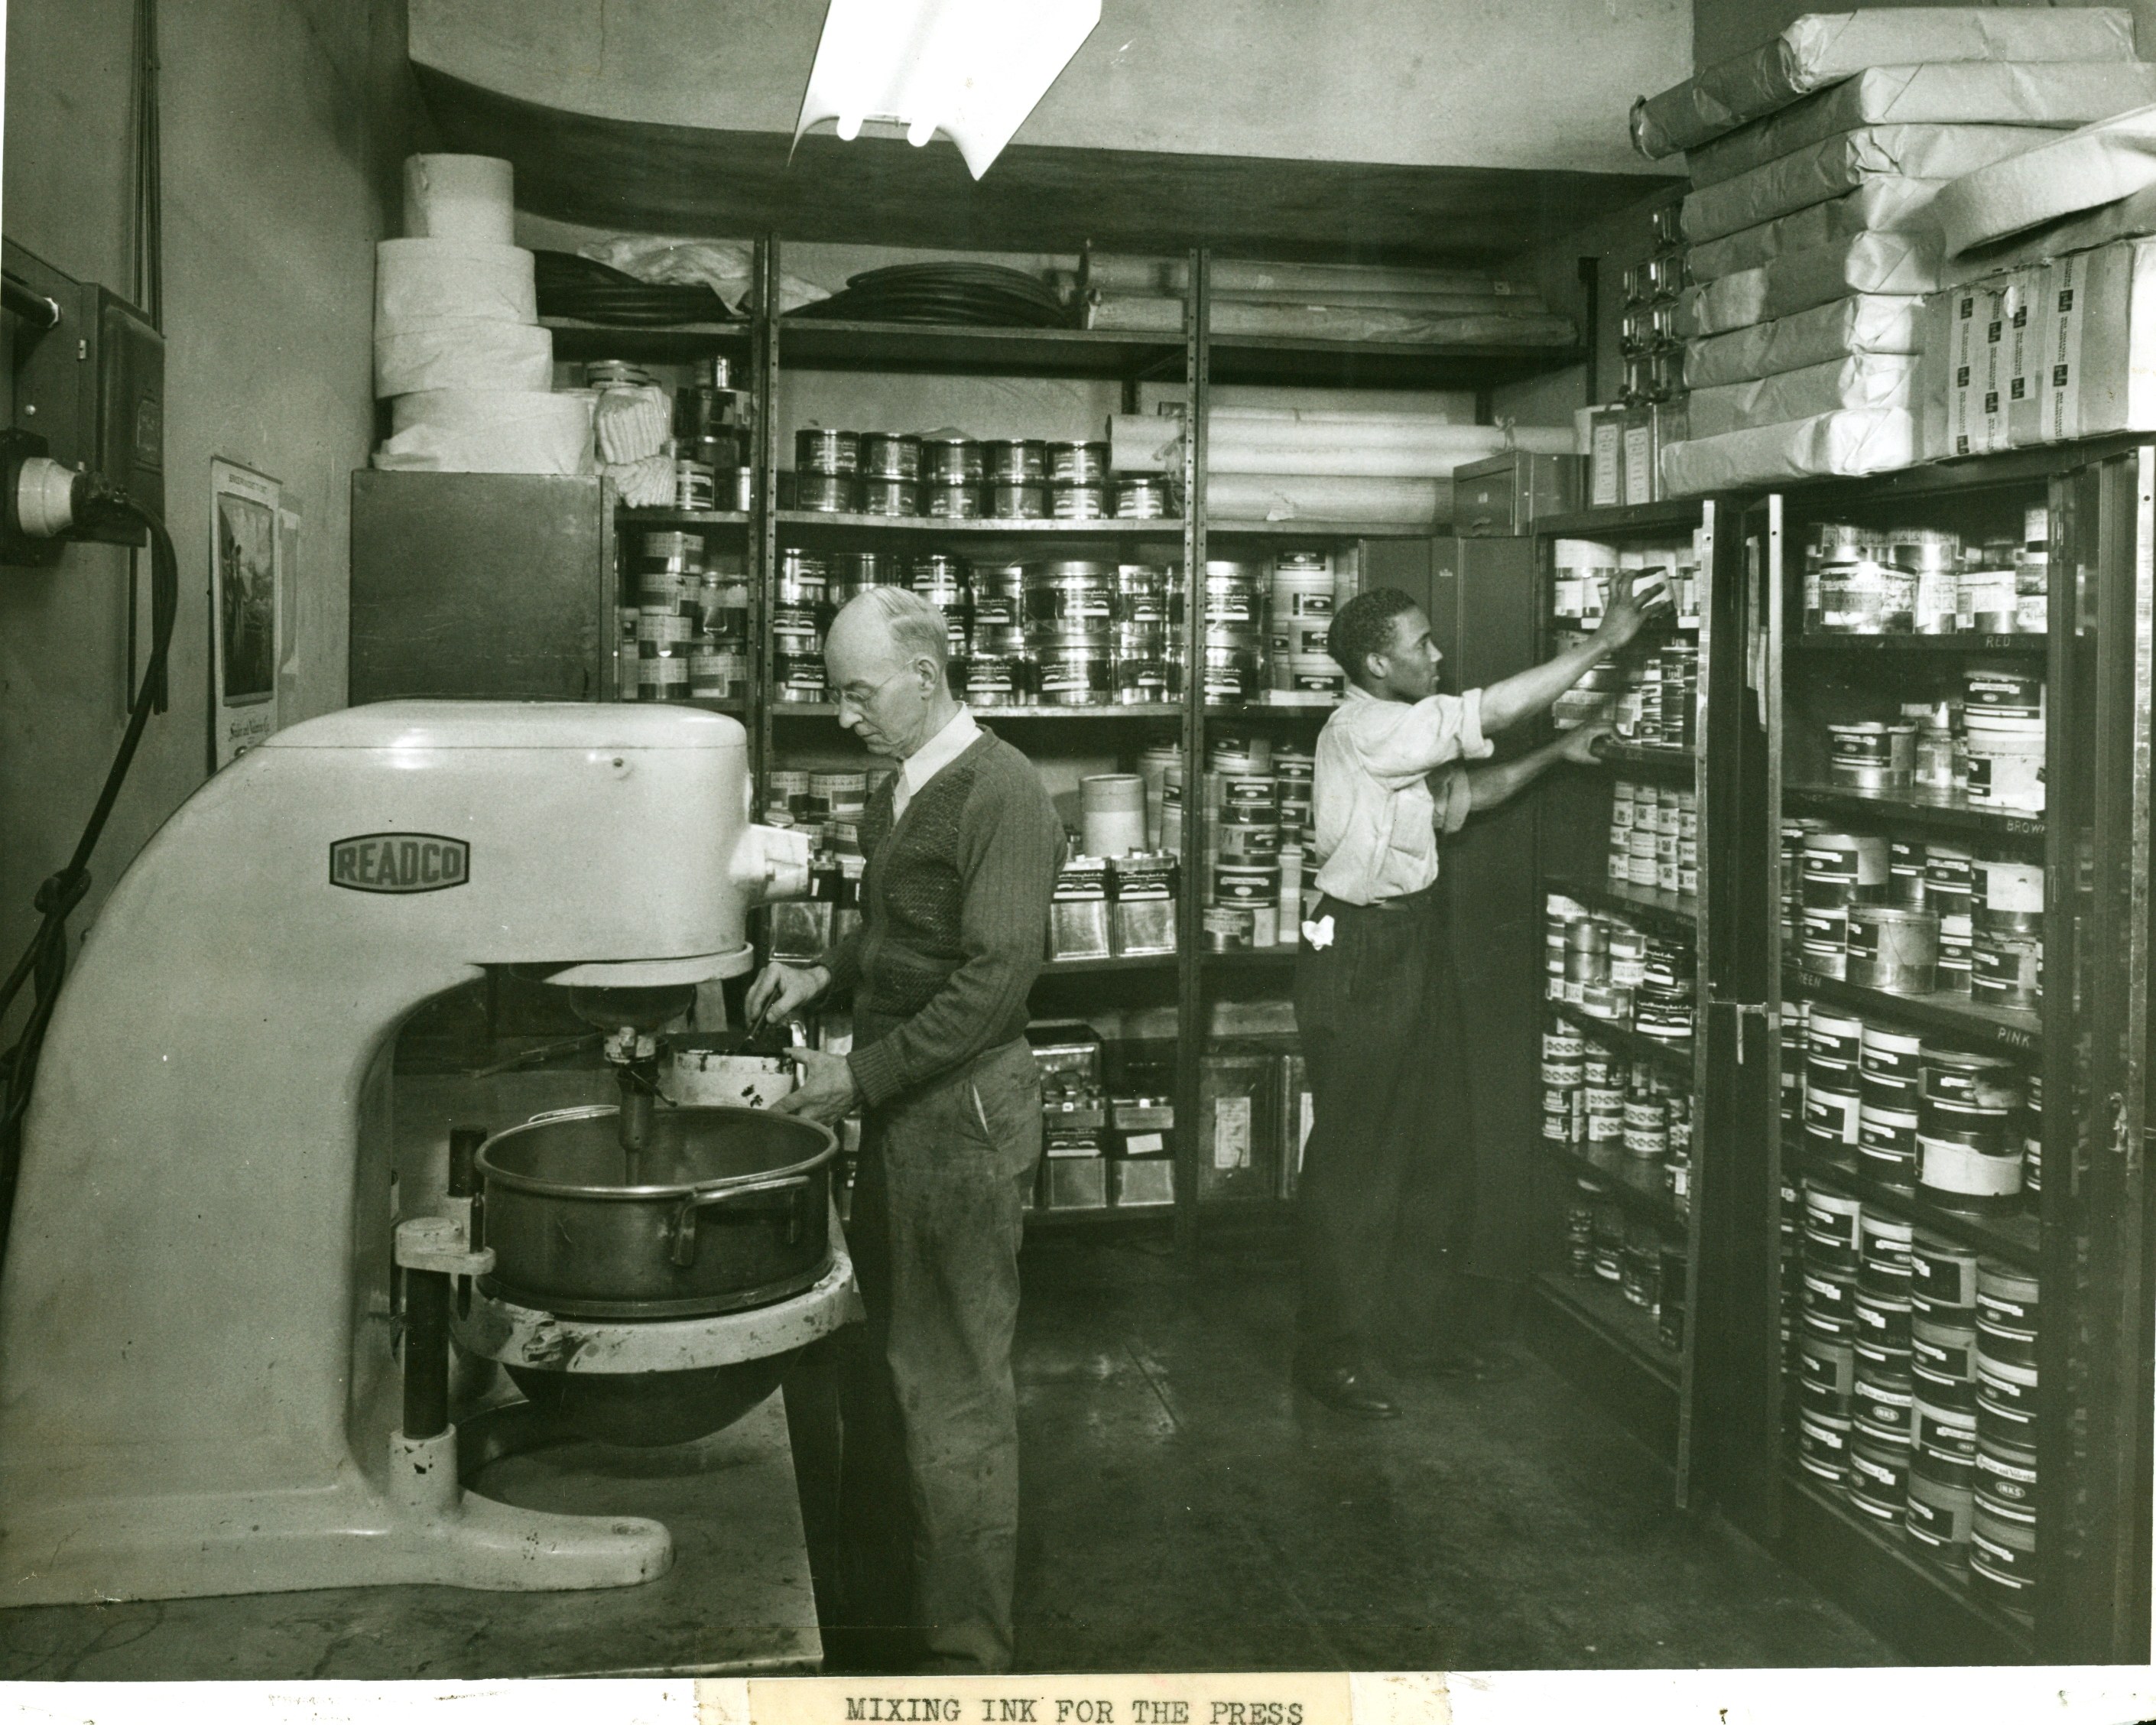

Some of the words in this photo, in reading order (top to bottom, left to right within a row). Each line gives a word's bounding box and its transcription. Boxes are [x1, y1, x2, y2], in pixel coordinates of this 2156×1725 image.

[1986, 635, 2011, 648] RED
[337, 841, 460, 885] READCO
[1797, 970, 1821, 987] REEN
[1998, 1027, 2031, 1048] PINK
[1876, 1409, 1896, 1420] INKS
[1999, 1484, 2021, 1497] INKS
